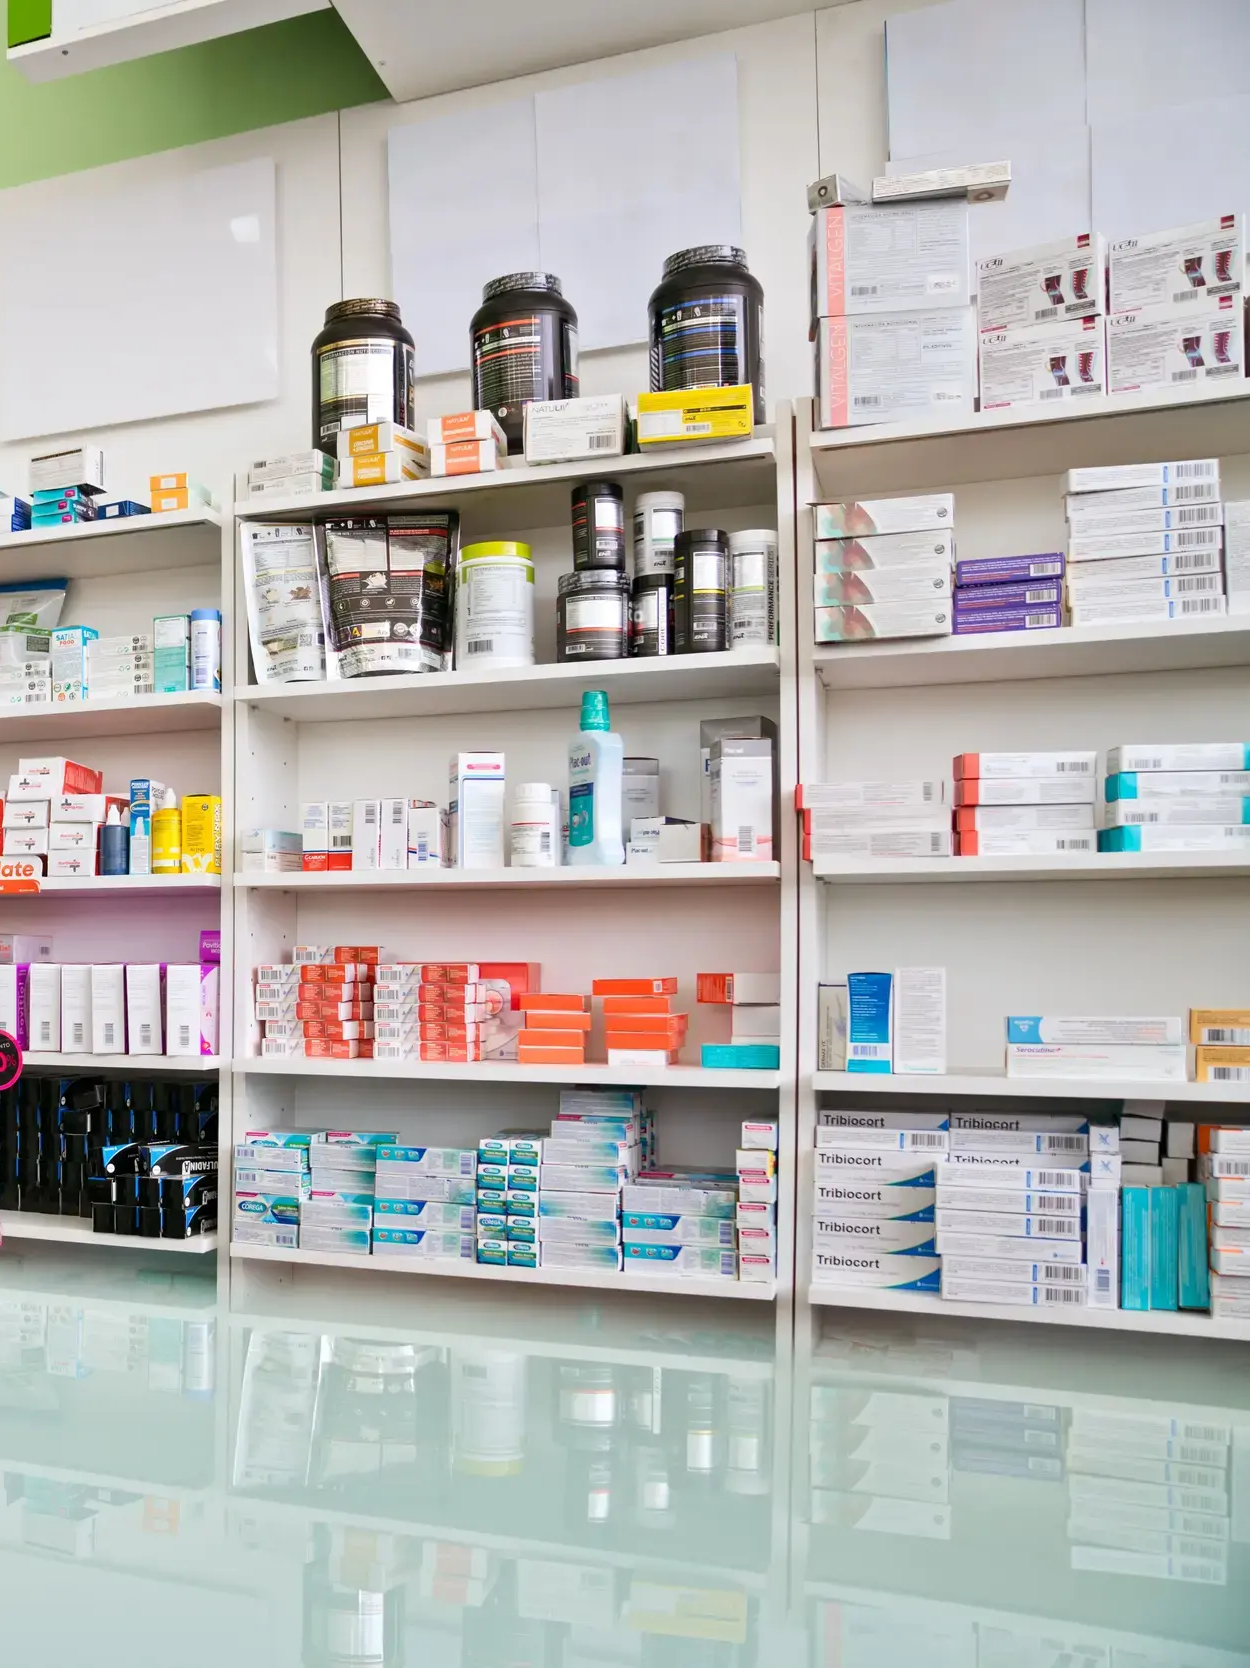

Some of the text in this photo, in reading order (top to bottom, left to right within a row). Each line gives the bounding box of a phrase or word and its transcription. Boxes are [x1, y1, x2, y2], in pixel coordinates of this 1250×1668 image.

[767, 580, 775, 641] PERFORMANCE
[823, 1114, 885, 1128] Tribiocort
[818, 1153, 882, 1166] Tribiocort
[182, 1160, 219, 1175] ULFADINA
[818, 1187, 882, 1201] Tribiocort
[241, 1202, 264, 1212] COREGA
[817, 1221, 881, 1235] Tribiocort
[816, 1255, 880, 1269] Tribiocort
